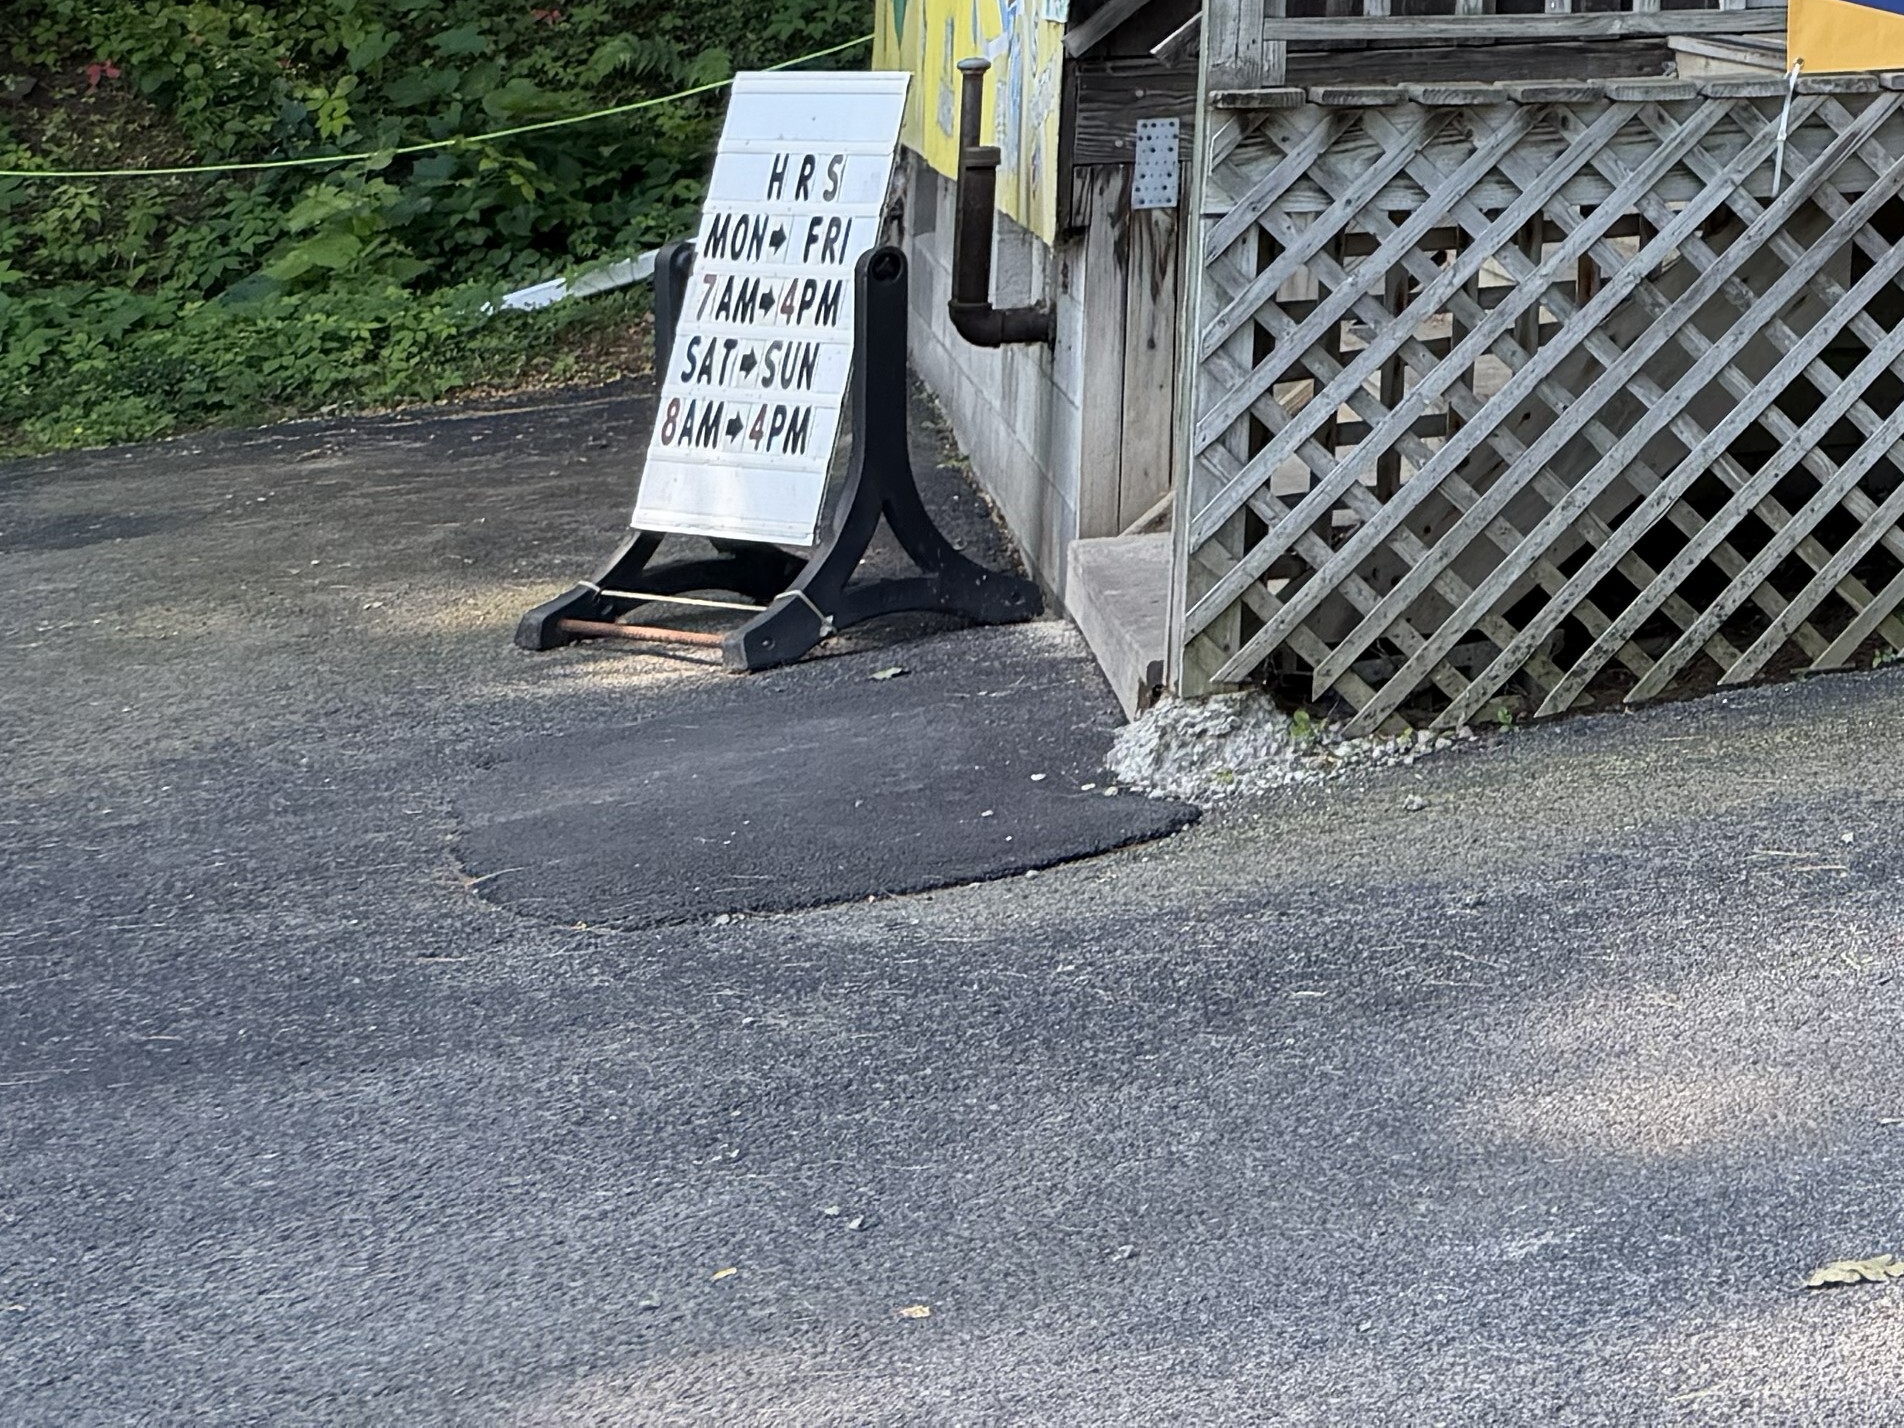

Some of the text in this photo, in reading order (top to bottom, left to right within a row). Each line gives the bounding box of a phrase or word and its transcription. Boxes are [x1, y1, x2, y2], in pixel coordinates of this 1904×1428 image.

[704, 213, 853, 265] MON FRI
[697, 274, 843, 328] 7AM 4PM
[680, 336, 817, 392] SAT SUN
[660, 398, 811, 456] 8AM 4PM
